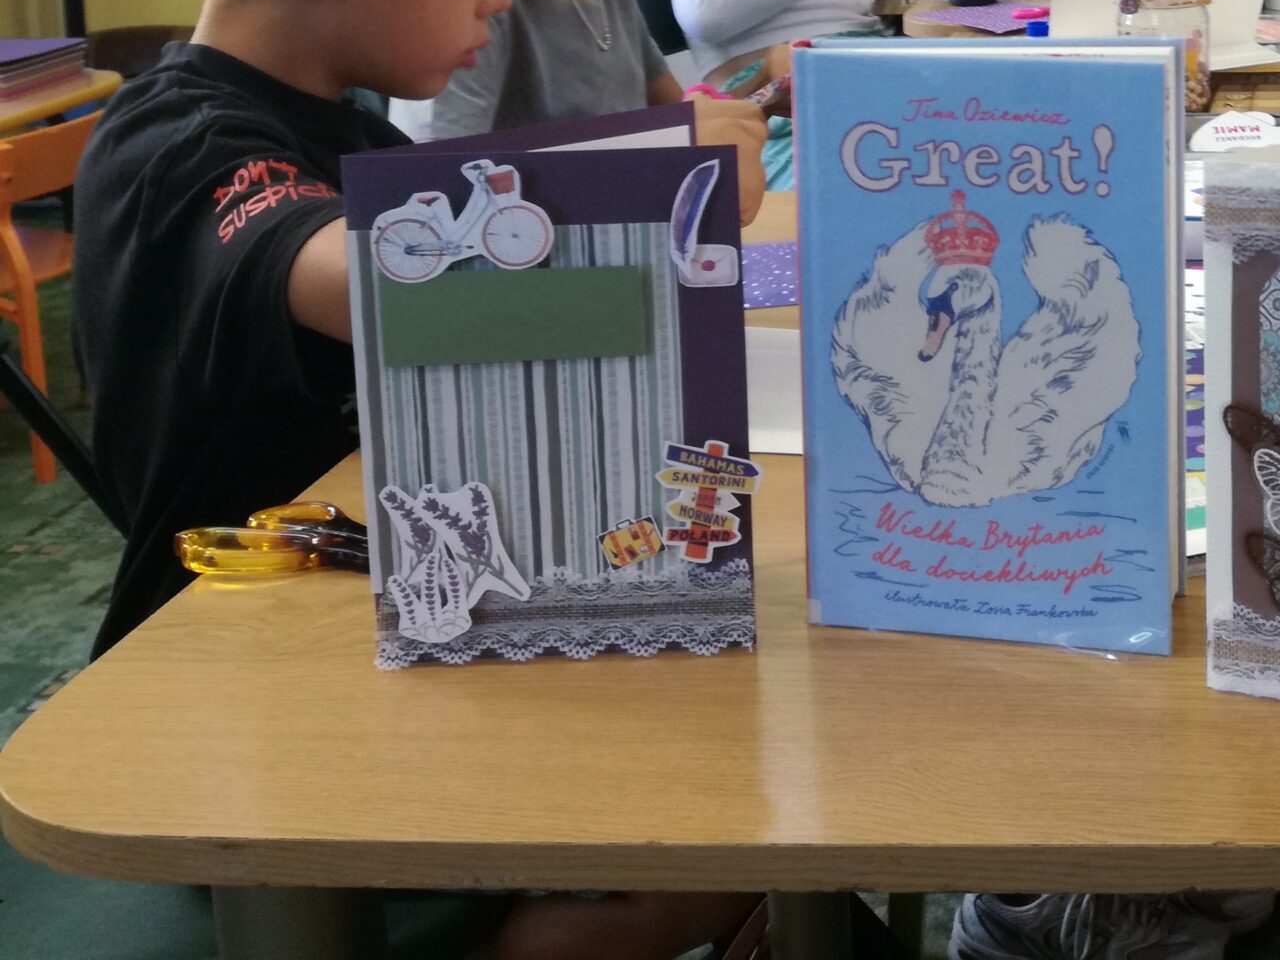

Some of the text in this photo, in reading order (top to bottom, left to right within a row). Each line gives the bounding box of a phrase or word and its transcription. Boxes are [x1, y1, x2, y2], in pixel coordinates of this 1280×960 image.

[902, 97, 1071, 126] Tina Oziewicz
[840, 120, 1115, 198] Great!
[680, 451, 745, 475] BAHAMAS
[672, 471, 746, 488] SANTORINI
[679, 505, 729, 527] NORWAY
[670, 529, 731, 542] POLAND
[876, 502, 1107, 558] Wielka Brytania
[872, 542, 1113, 596] dla dociekliwych
